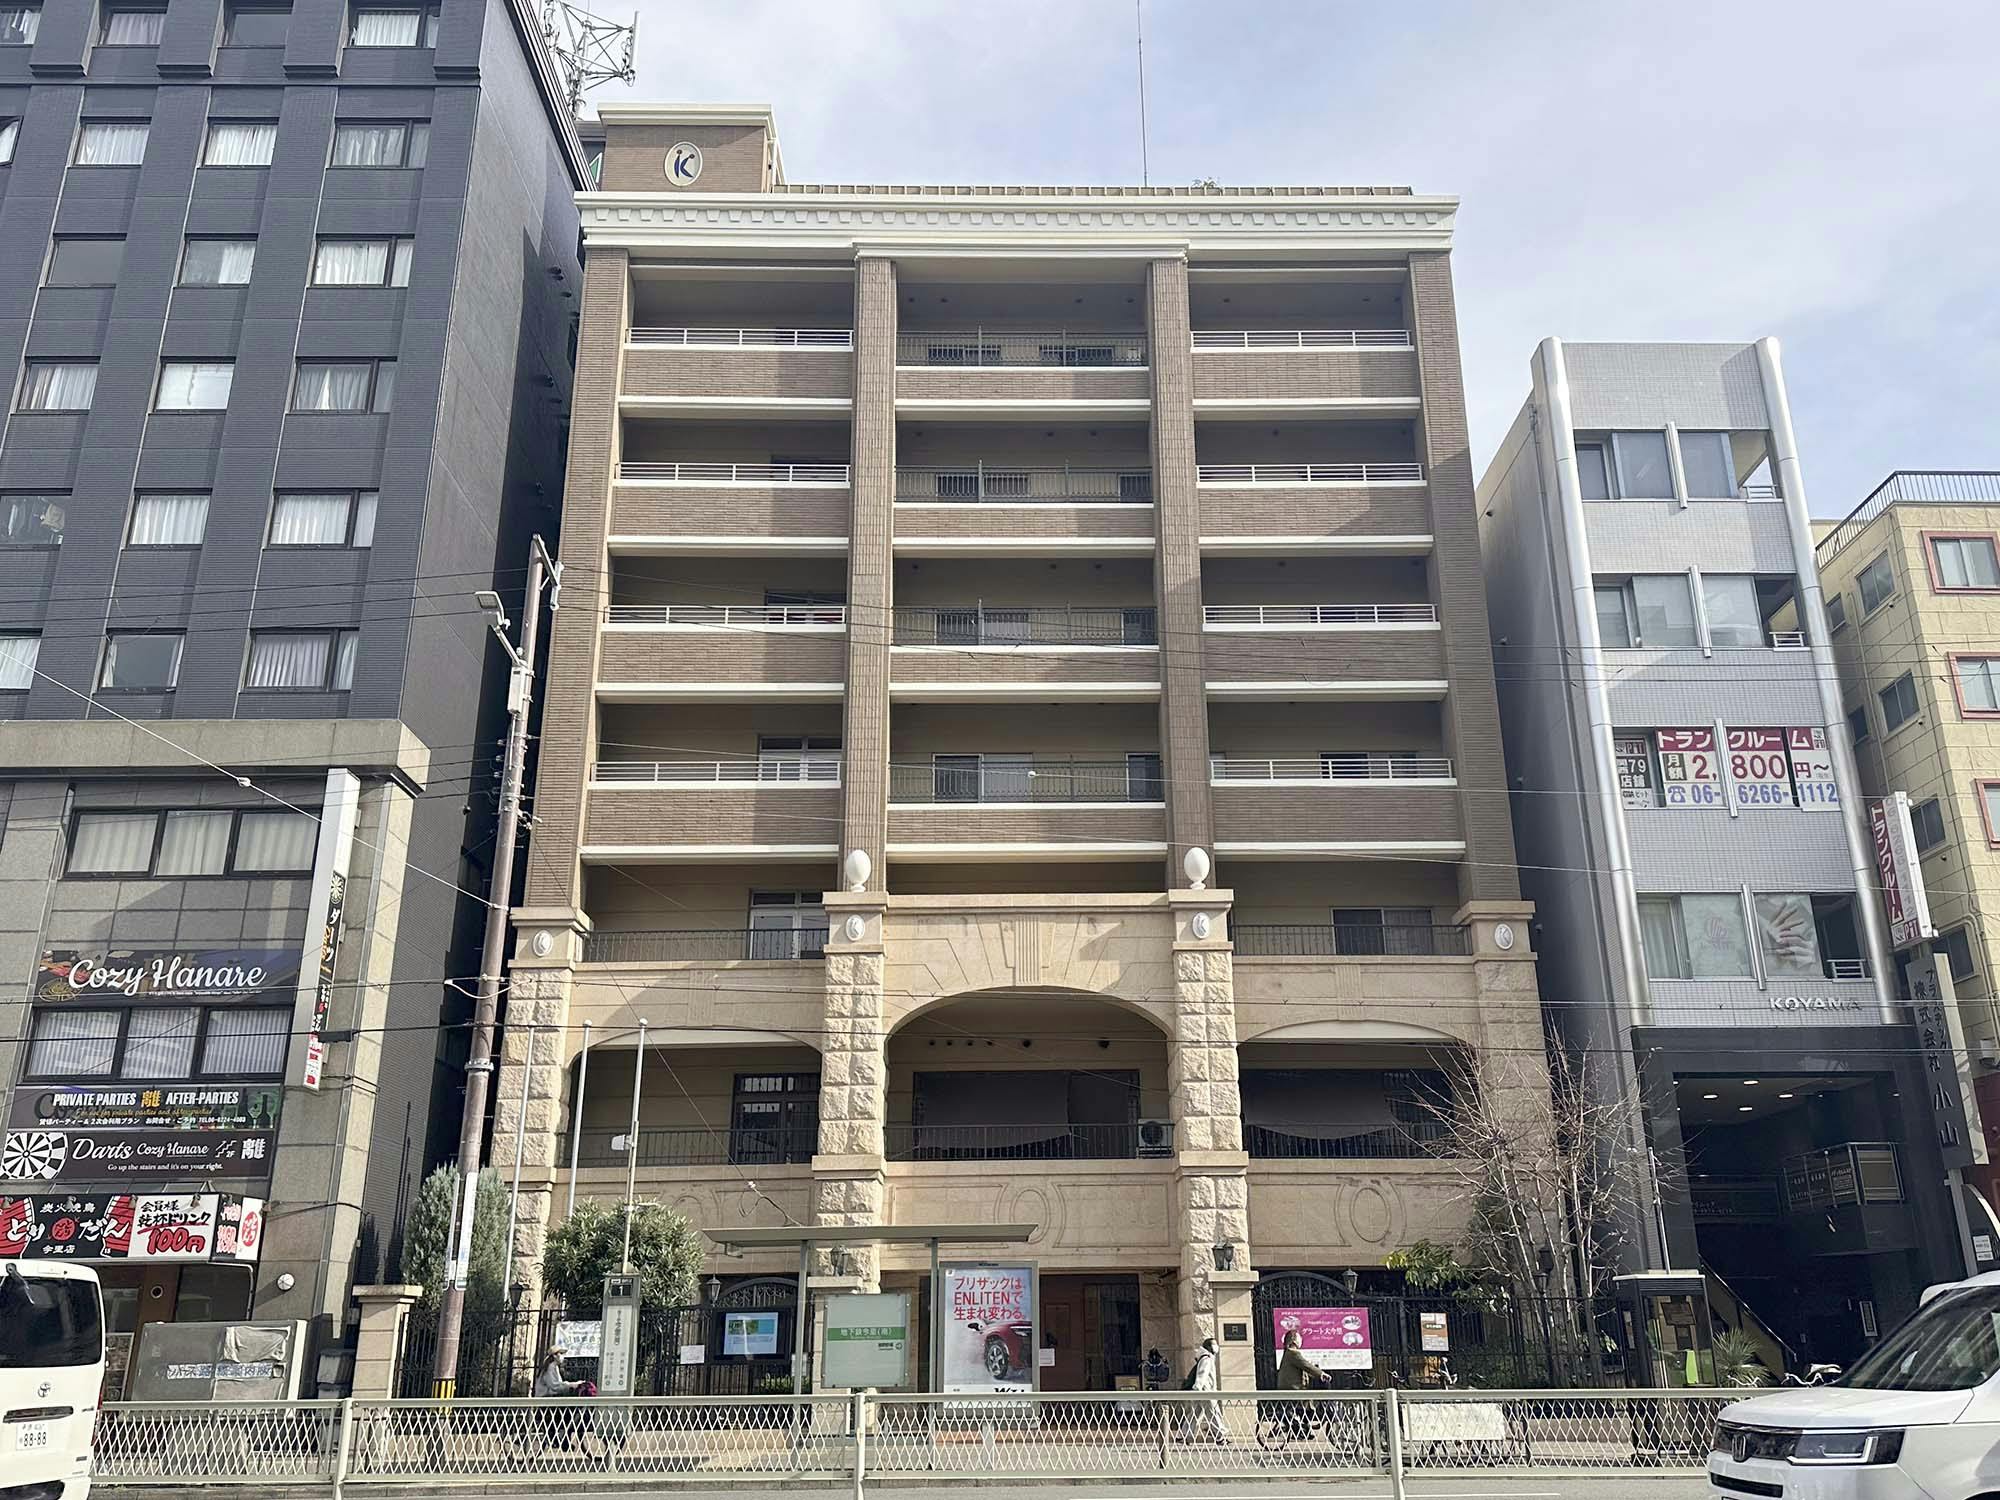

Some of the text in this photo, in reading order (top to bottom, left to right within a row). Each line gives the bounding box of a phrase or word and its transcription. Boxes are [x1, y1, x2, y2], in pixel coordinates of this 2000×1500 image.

[1657, 730, 1810, 748] トランクルーム
[1871, 806, 1903, 923] トランクルーム
[68, 956, 267, 996] Cozy Hanare
[1769, 997, 1862, 1011] KOYAMA
[53, 1092, 137, 1107] PRIVATE PARTIES
[165, 1091, 239, 1105] AFTER-PARTIES
[72, 1138, 208, 1160] Darts Cozy Hanare
[241, 1138, 265, 1159] 離
[40, 1202, 95, 1213] 炭火焼鳥
[141, 1200, 179, 1212] 会員様
[137, 1211, 211, 1227] 乾杯ドリンク
[147, 1227, 206, 1255] 100円
[43, 1245, 75, 1254] 今里店
[954, 1291, 1023, 1305] ENLITENで
[23, 1431, 46, 1446] 88-88
